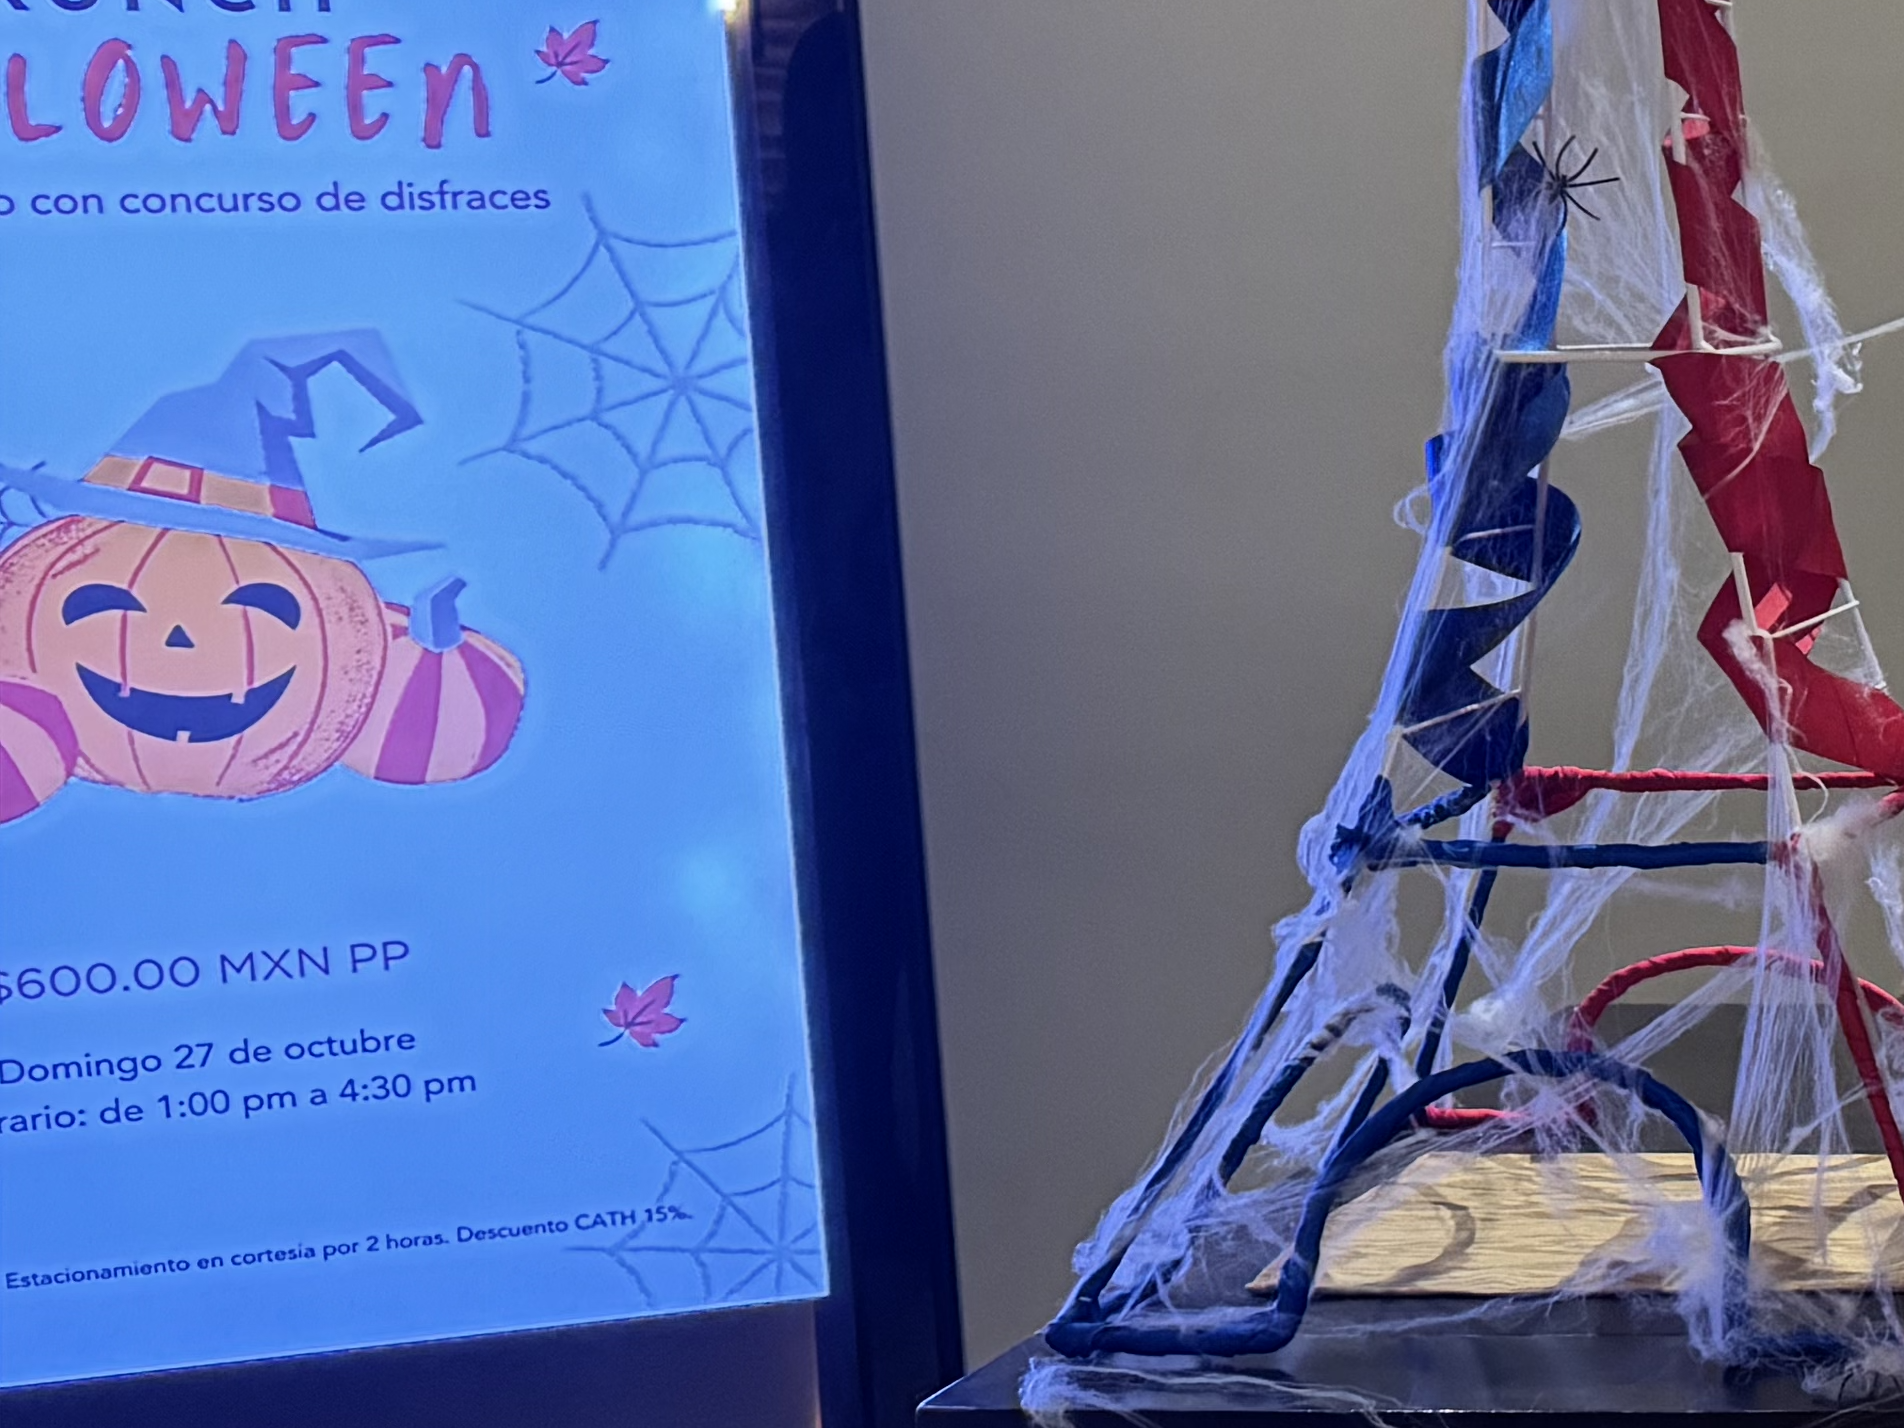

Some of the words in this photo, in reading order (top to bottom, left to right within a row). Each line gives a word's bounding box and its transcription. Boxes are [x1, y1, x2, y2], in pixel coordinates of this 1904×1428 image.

[30, 191, 105, 215] con
[119, 187, 302, 215] concurso
[314, 180, 366, 214] de
[379, 177, 551, 212] disfraces
[220, 946, 330, 984] MXN
[349, 940, 410, 973] PP
[0, 1051, 162, 1085] Domingo
[173, 1042, 214, 1070] 27
[229, 1038, 272, 1065] de
[284, 1028, 416, 1060] octubre
[99, 1097, 144, 1124] de
[157, 1089, 230, 1119] 1:00
[243, 1091, 297, 1119] pm
[309, 1088, 328, 1106] a
[338, 1073, 411, 1103] 4:30
[423, 1075, 477, 1103] pm
[5, 1259, 191, 1290] Estacionamiento
[196, 1256, 224, 1270] en
[322, 1241, 359, 1261] por
[366, 1236, 380, 1252] 2
[385, 1232, 449, 1250] horas.
[456, 1220, 569, 1244] Descuento
[574, 1209, 636, 1231] CATH
